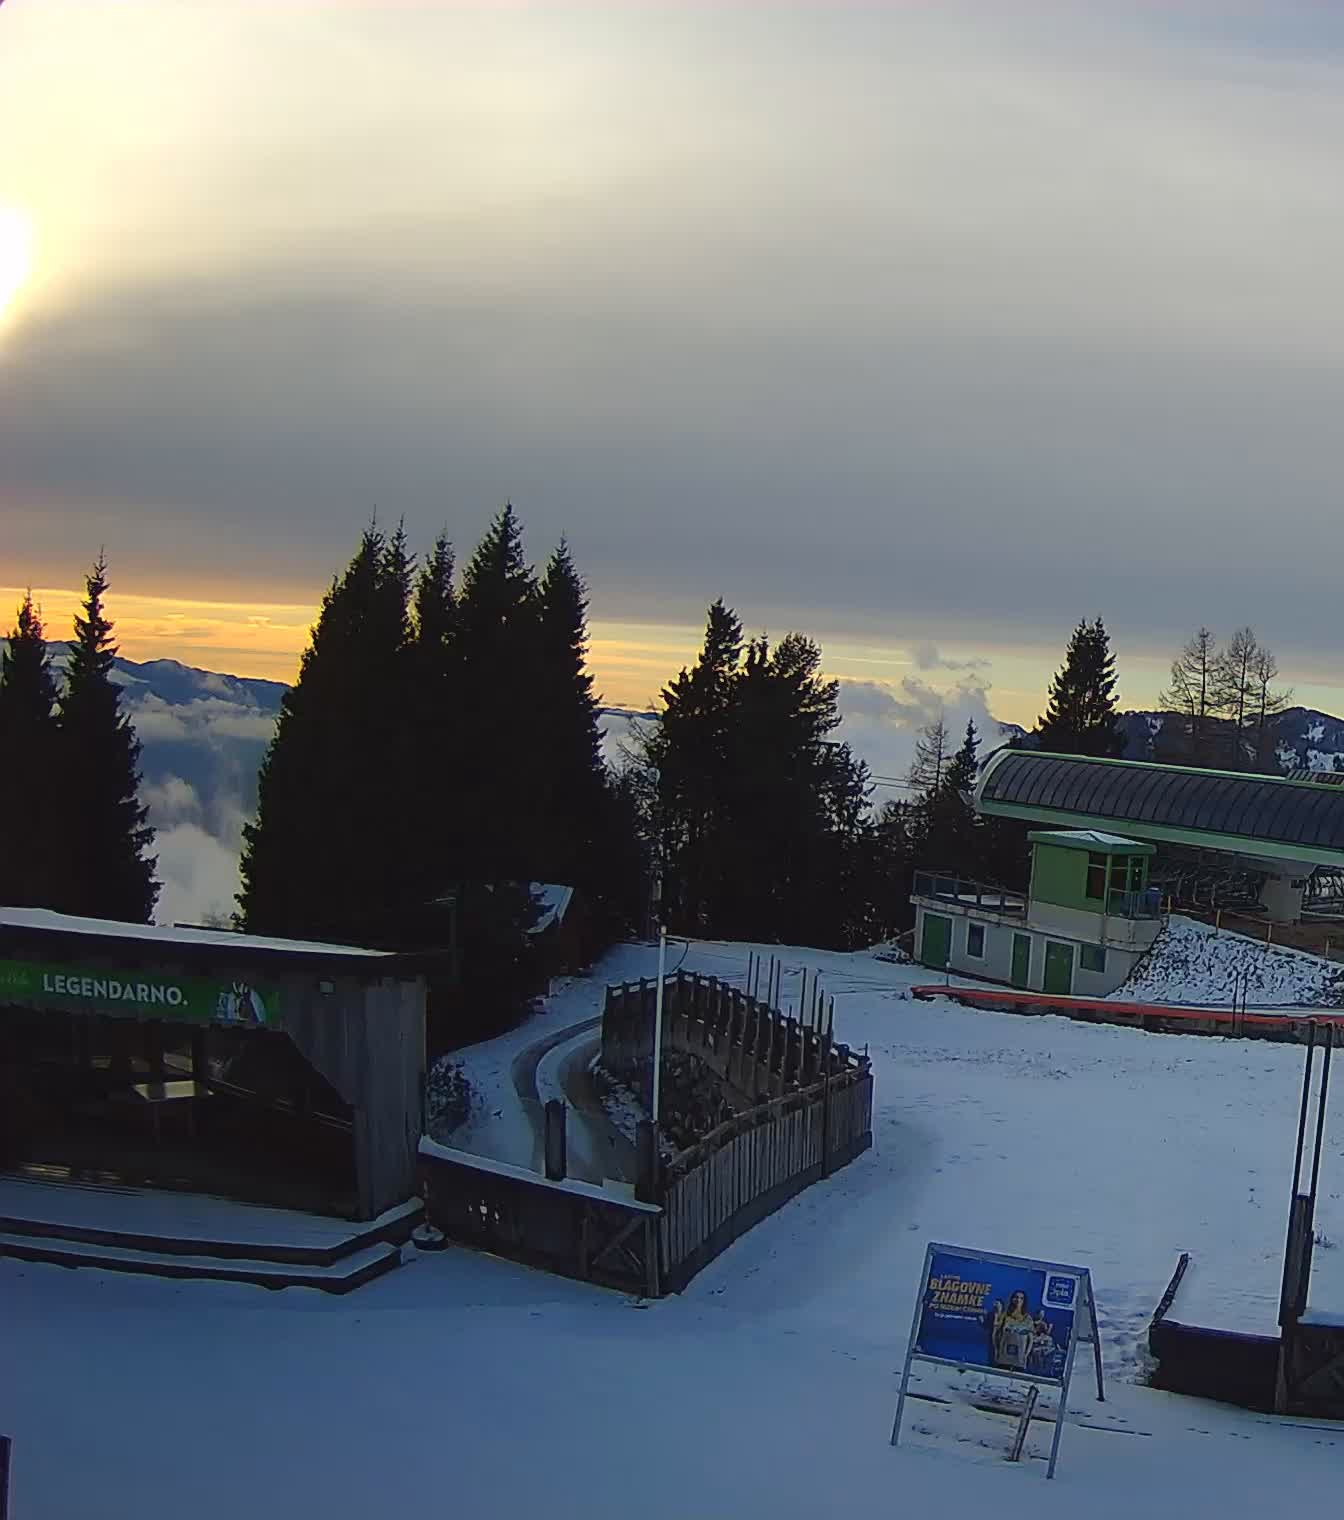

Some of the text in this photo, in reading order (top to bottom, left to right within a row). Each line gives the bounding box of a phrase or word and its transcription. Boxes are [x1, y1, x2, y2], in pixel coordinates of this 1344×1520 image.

[43, 974, 189, 1006] LEGENDARNO.
[930, 1278, 992, 1296] BLAGOVNE
[933, 1291, 984, 1306] ZNAMKE
